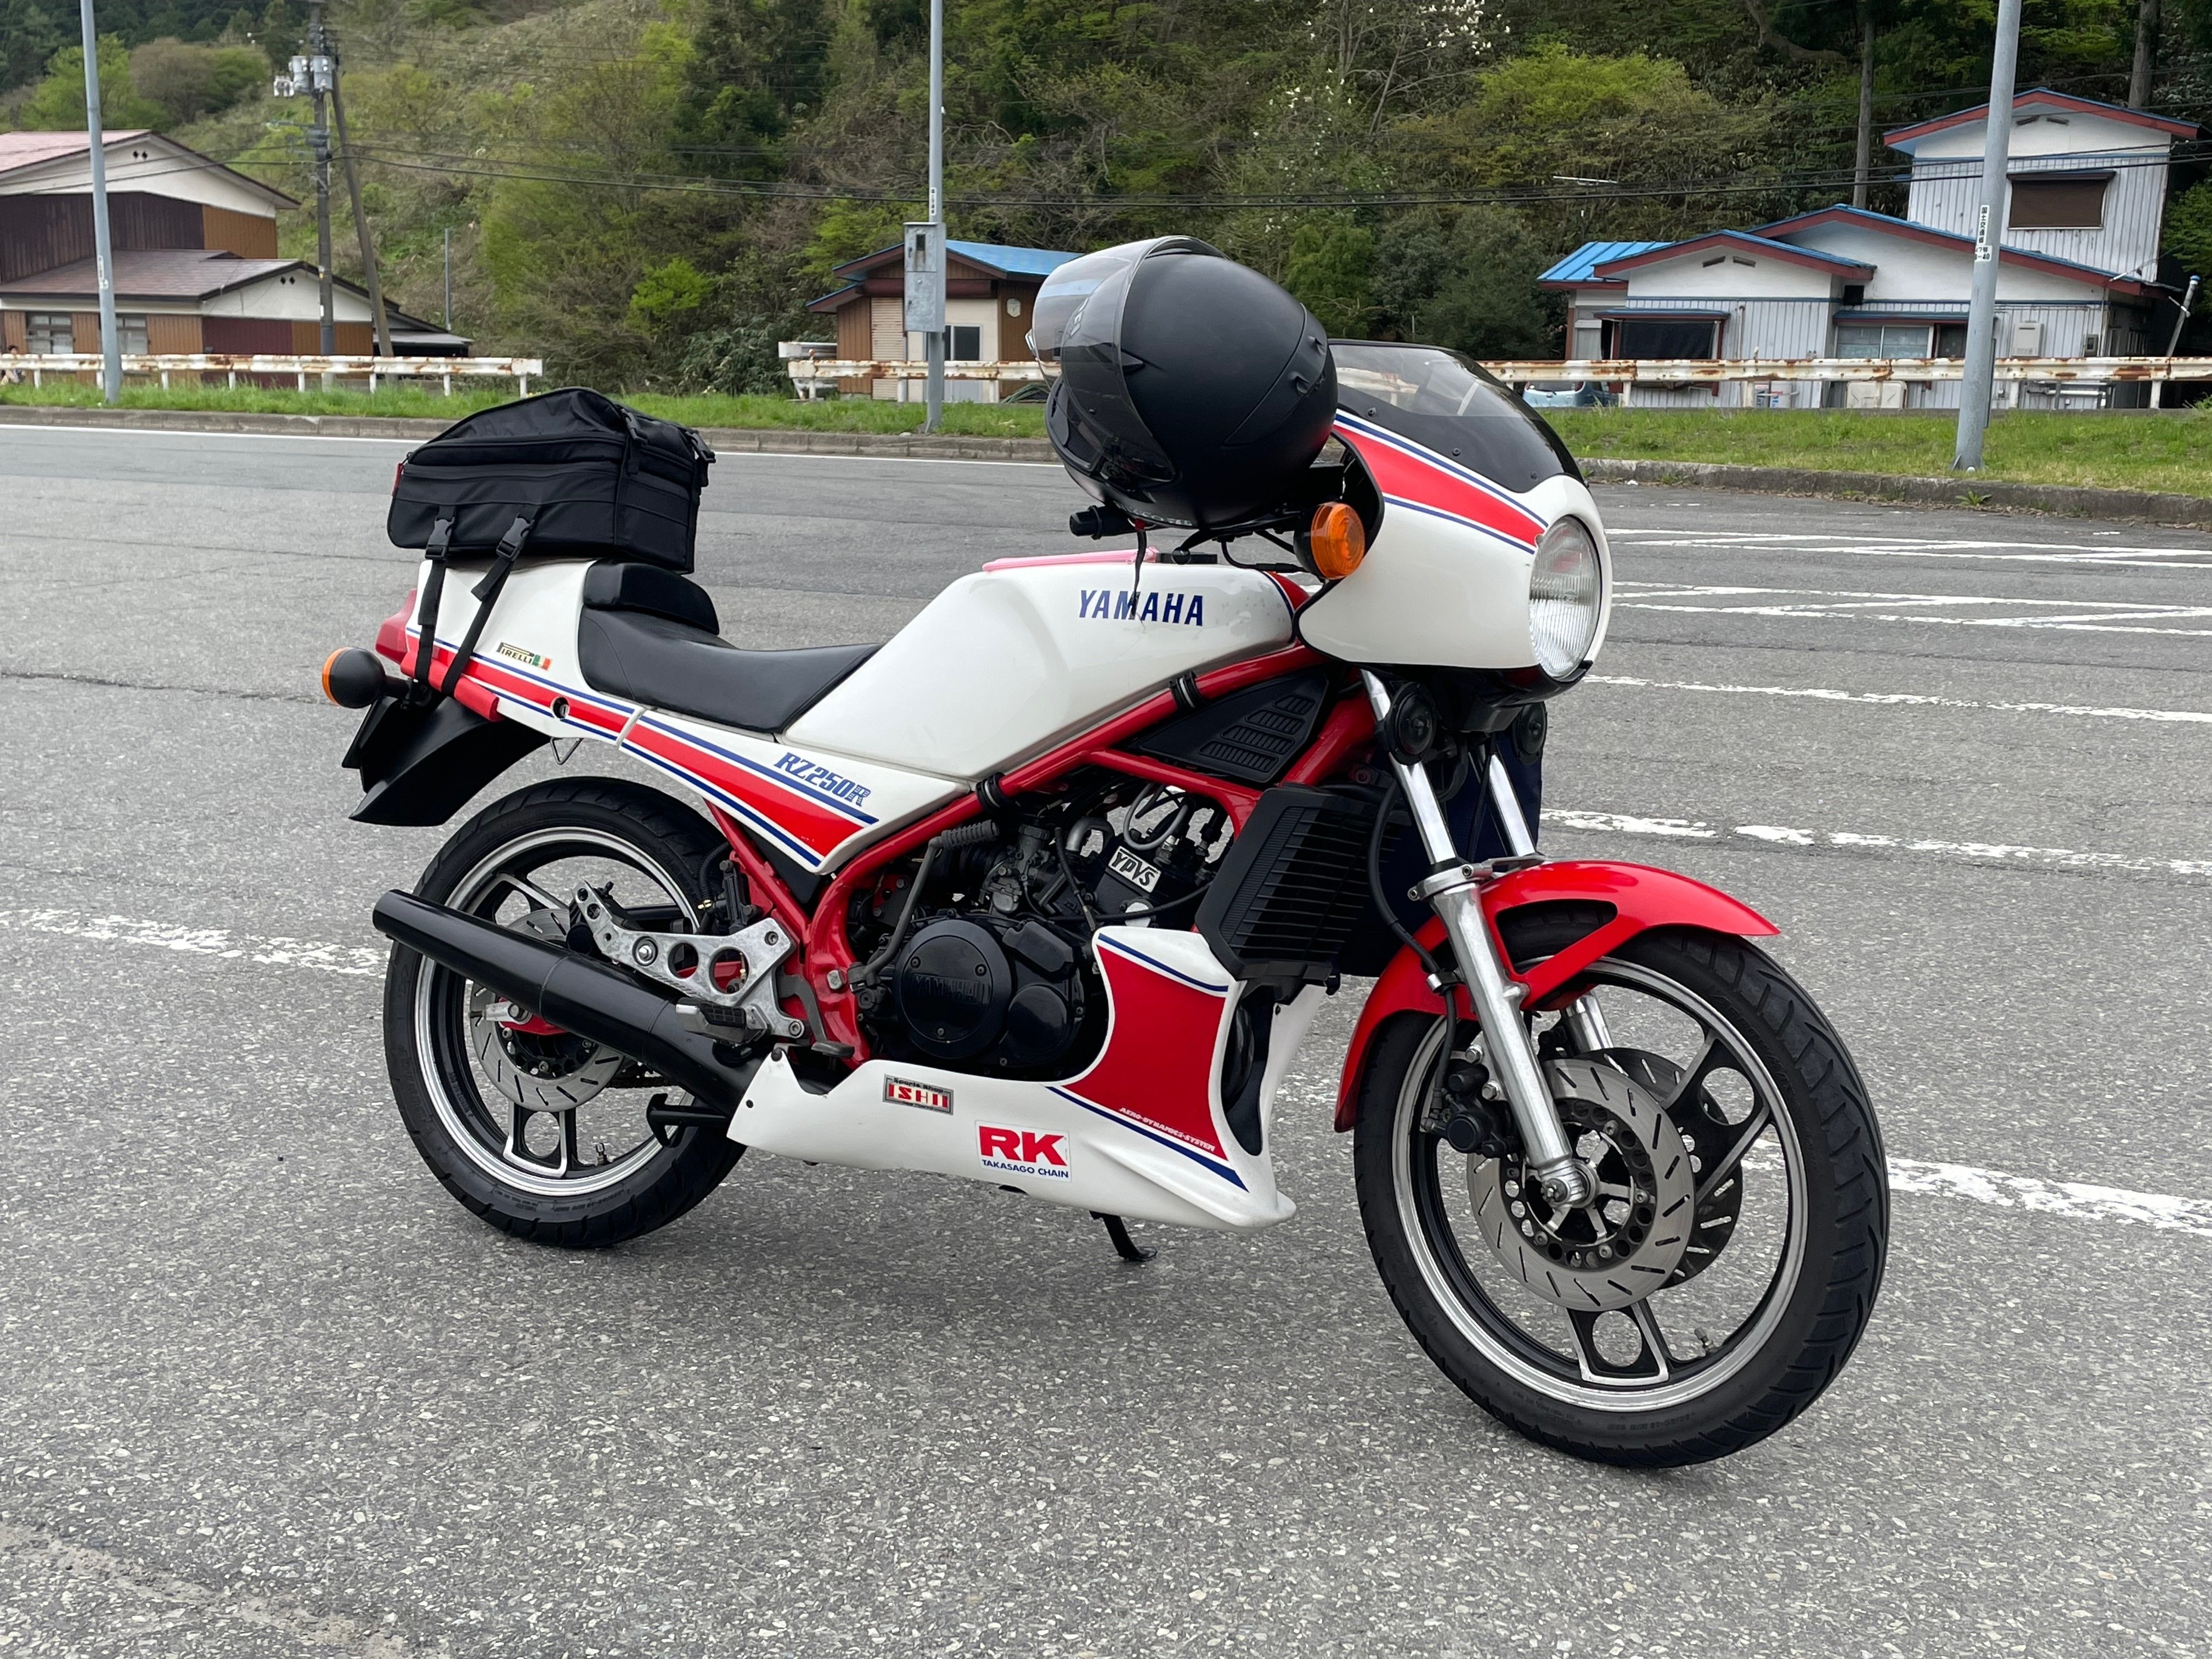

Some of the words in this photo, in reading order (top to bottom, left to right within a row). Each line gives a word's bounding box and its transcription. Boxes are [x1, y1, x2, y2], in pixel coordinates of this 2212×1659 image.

[1079, 590, 1203, 627] YAMAHA
[496, 642, 535, 664] PIRELLI
[774, 752, 871, 806] RZ250R
[1111, 848, 1159, 887] YPVS
[888, 1084, 948, 1108] ISHII
[894, 1077, 921, 1088] Sports
[923, 1084, 944, 1093] Shop
[979, 1126, 1068, 1166] RK
[982, 1159, 1035, 1174] TAKASAGO
[1038, 1168, 1069, 1178] CHAIN
